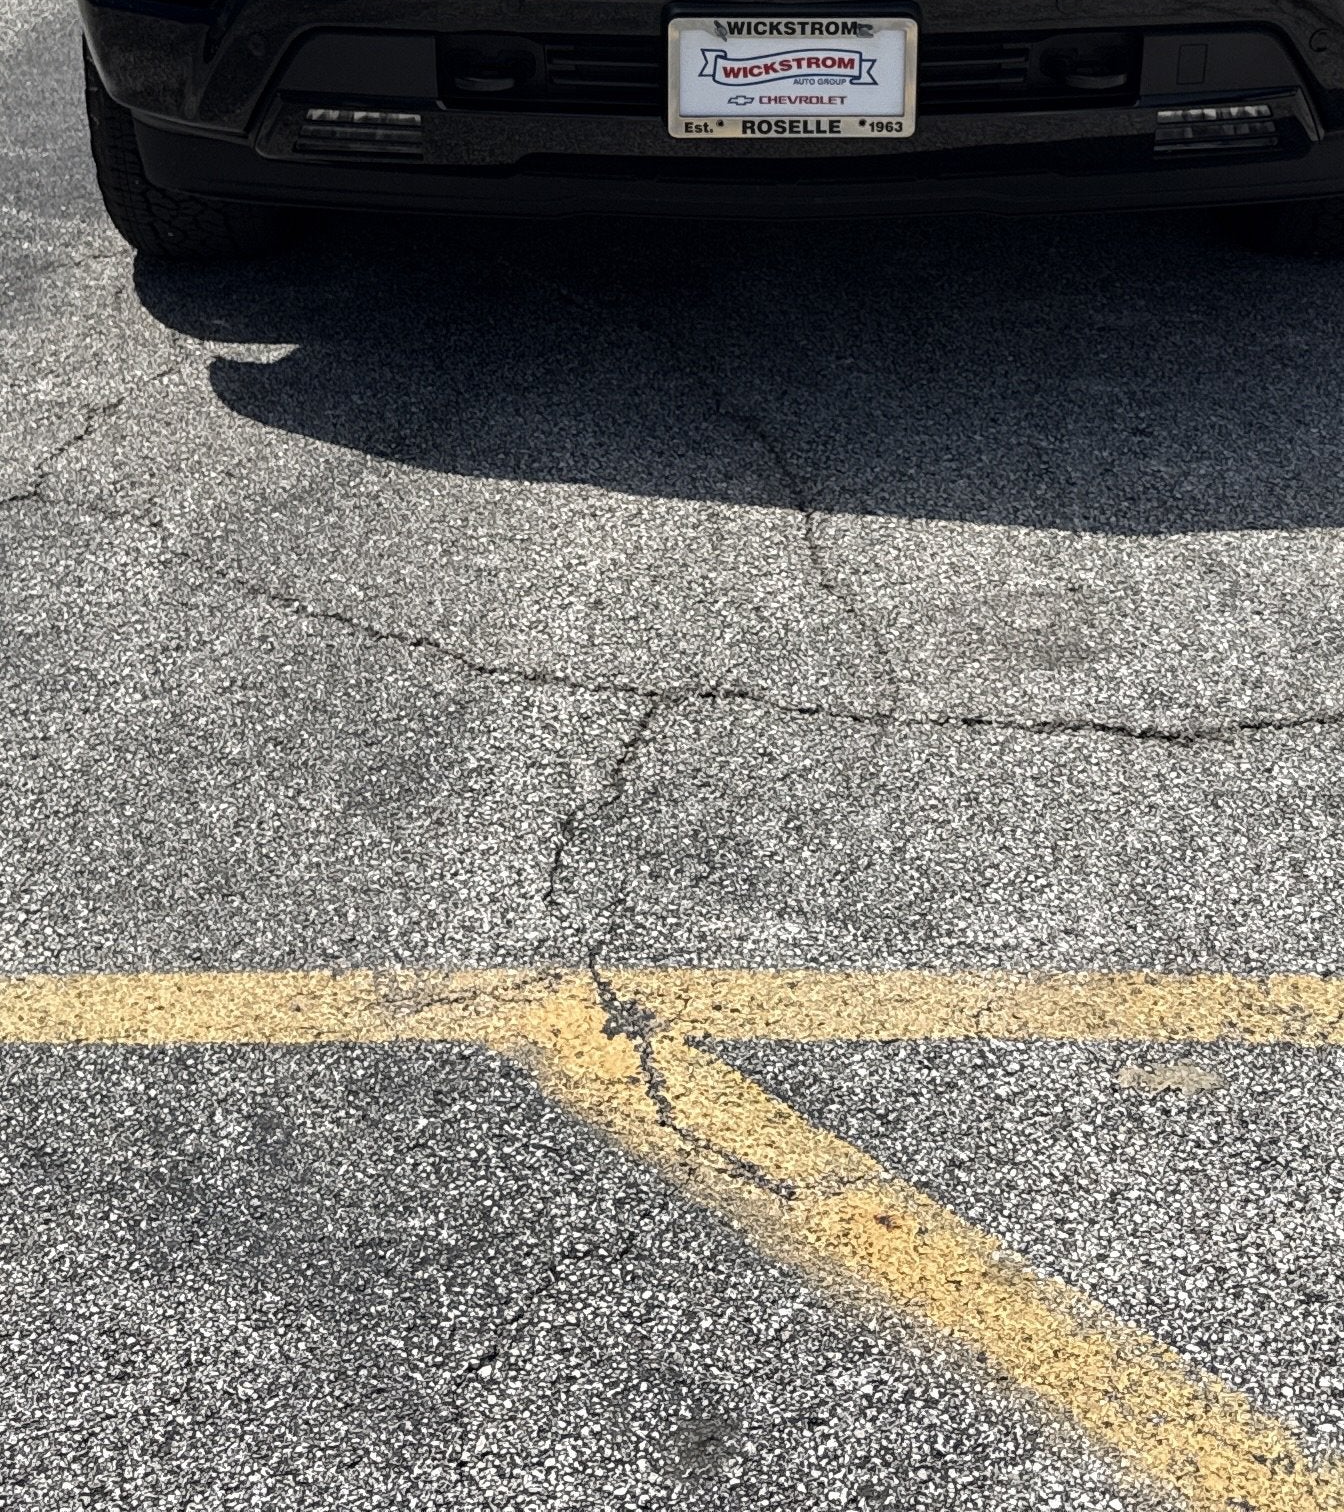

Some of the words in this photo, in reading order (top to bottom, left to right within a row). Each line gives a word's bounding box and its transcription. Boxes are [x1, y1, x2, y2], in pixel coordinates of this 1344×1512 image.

[727, 21, 857, 36] WICKSTROM
[722, 56, 856, 79] WICKSTROM
[792, 77, 816, 86] AUTO
[817, 77, 847, 86] GROUP
[759, 95, 848, 105] CHEVROLET
[684, 122, 714, 134] Est.
[741, 120, 841, 134] ROSELLE
[869, 121, 903, 133] 1963
